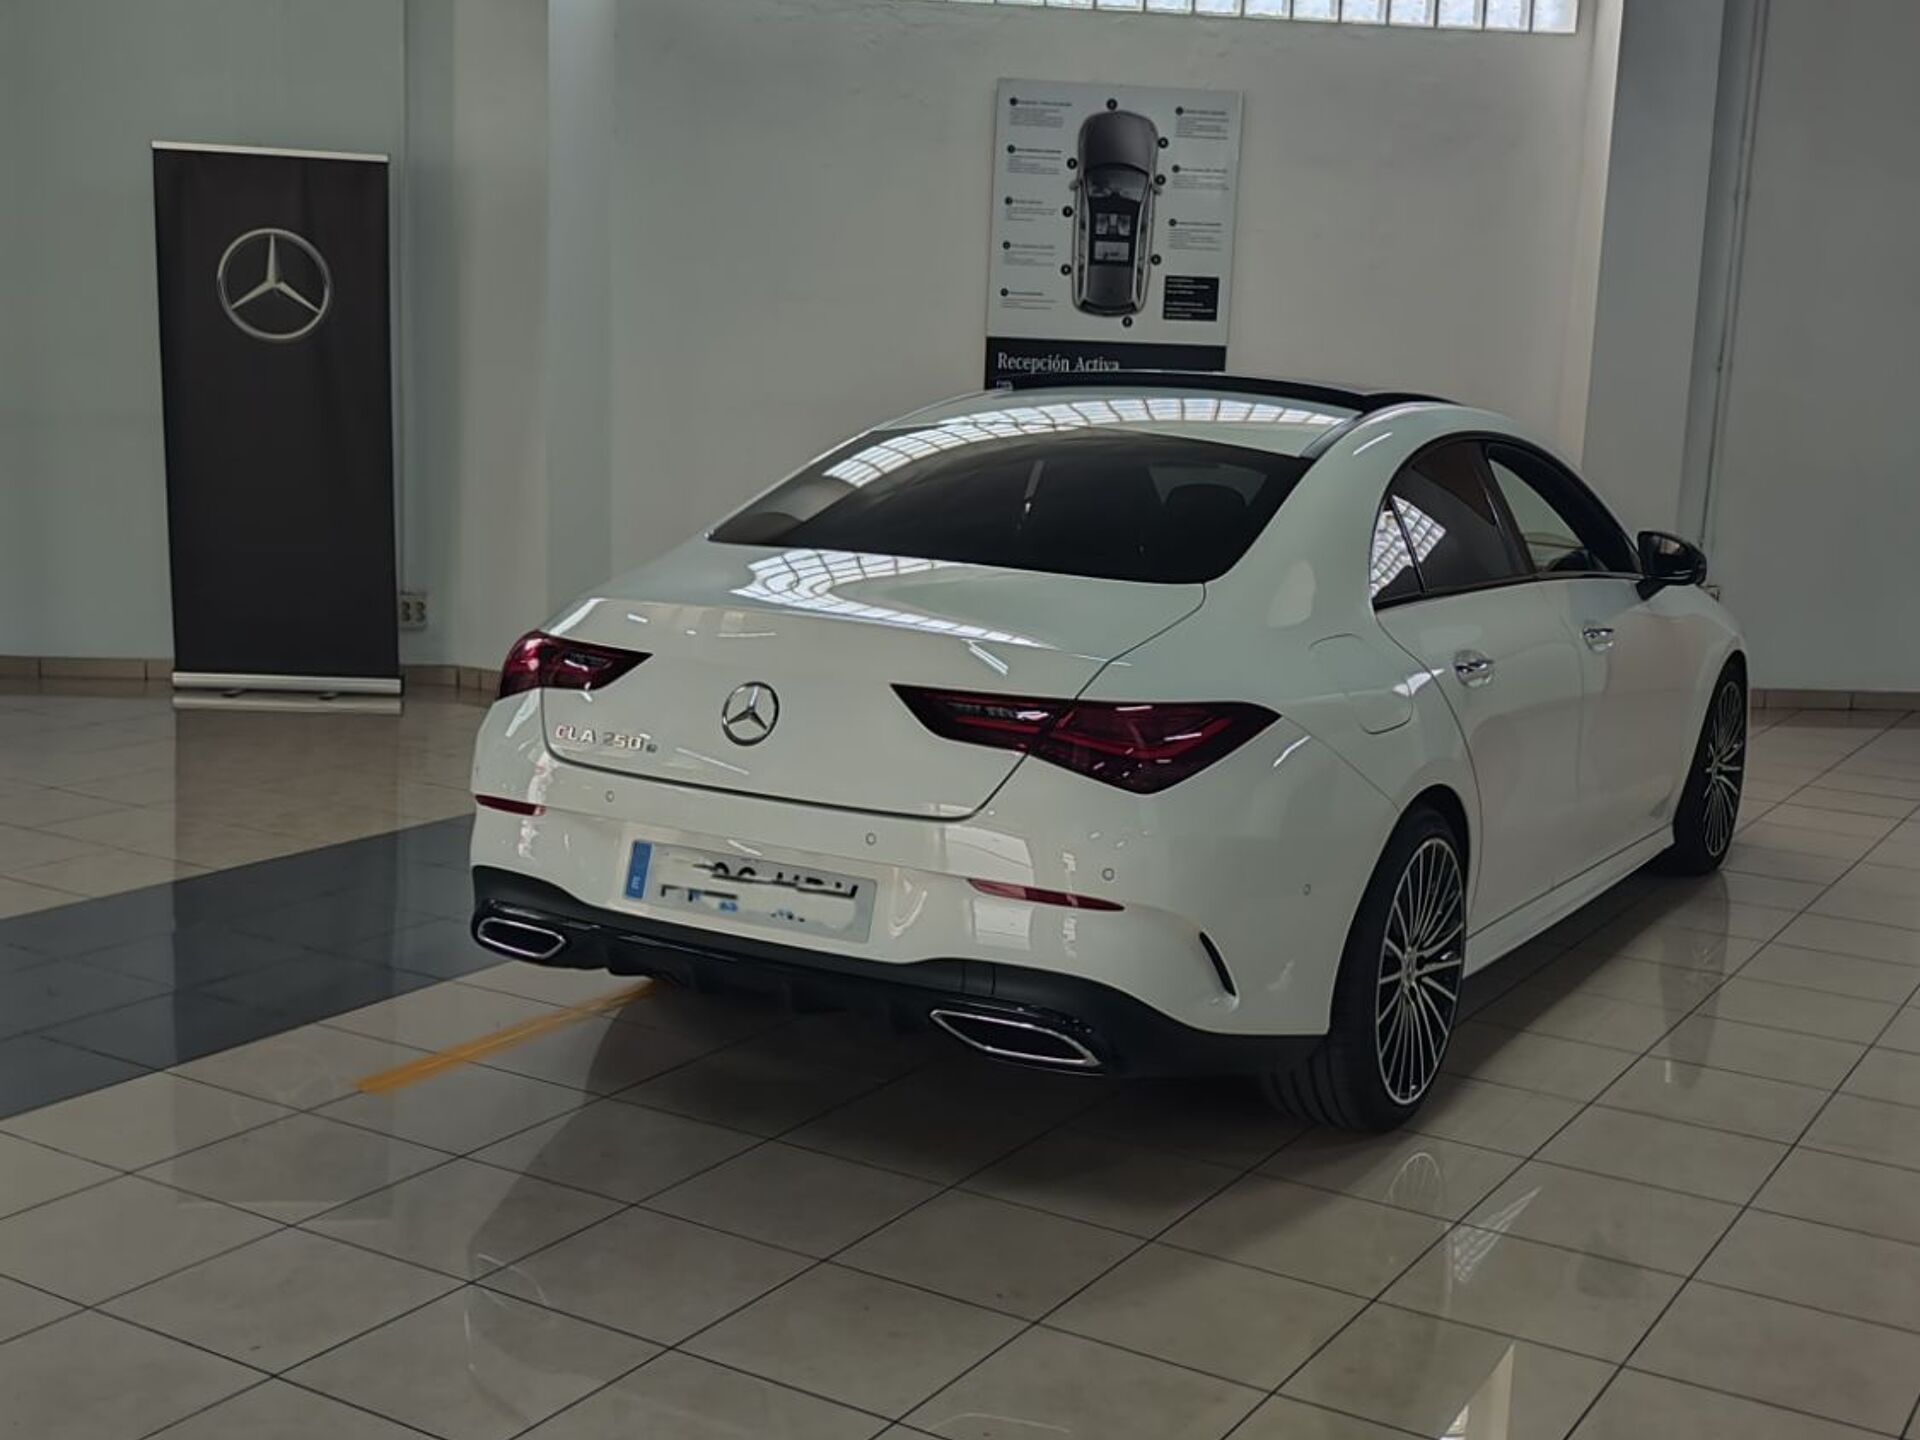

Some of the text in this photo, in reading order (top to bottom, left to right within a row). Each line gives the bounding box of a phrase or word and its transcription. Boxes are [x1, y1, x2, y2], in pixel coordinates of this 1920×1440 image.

[997, 351, 1121, 375] Recepción Activa
[555, 724, 597, 745] CLA
